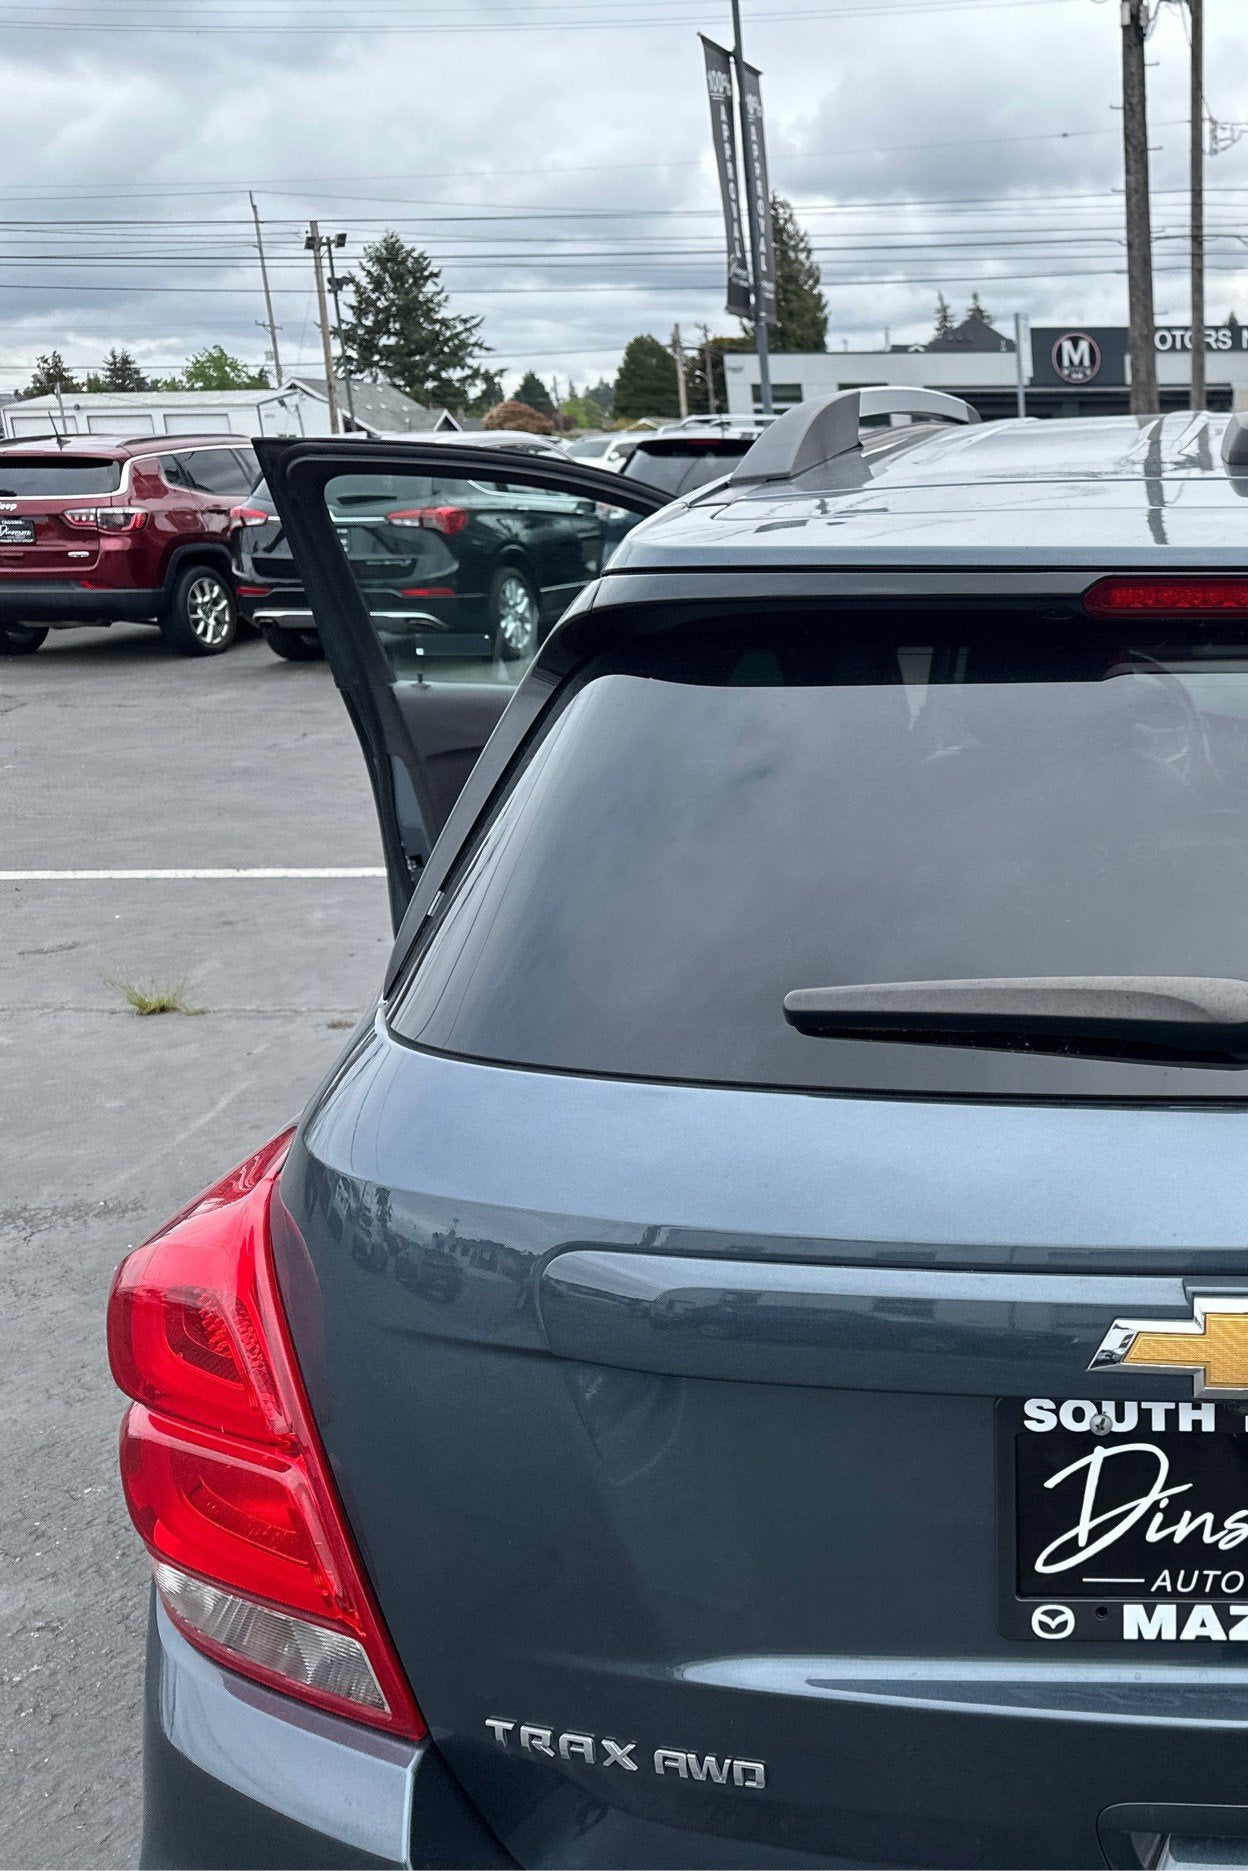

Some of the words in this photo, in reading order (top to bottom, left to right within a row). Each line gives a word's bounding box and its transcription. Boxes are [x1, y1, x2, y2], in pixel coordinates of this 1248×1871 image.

[1061, 339, 1090, 367] M
[1154, 328, 1232, 350] OTRS
[1024, 1399, 1215, 1432] SOUTH
[1151, 1569, 1245, 1594] AUTO
[485, 1717, 639, 1771] TRAX
[654, 1748, 766, 1789] AWD
